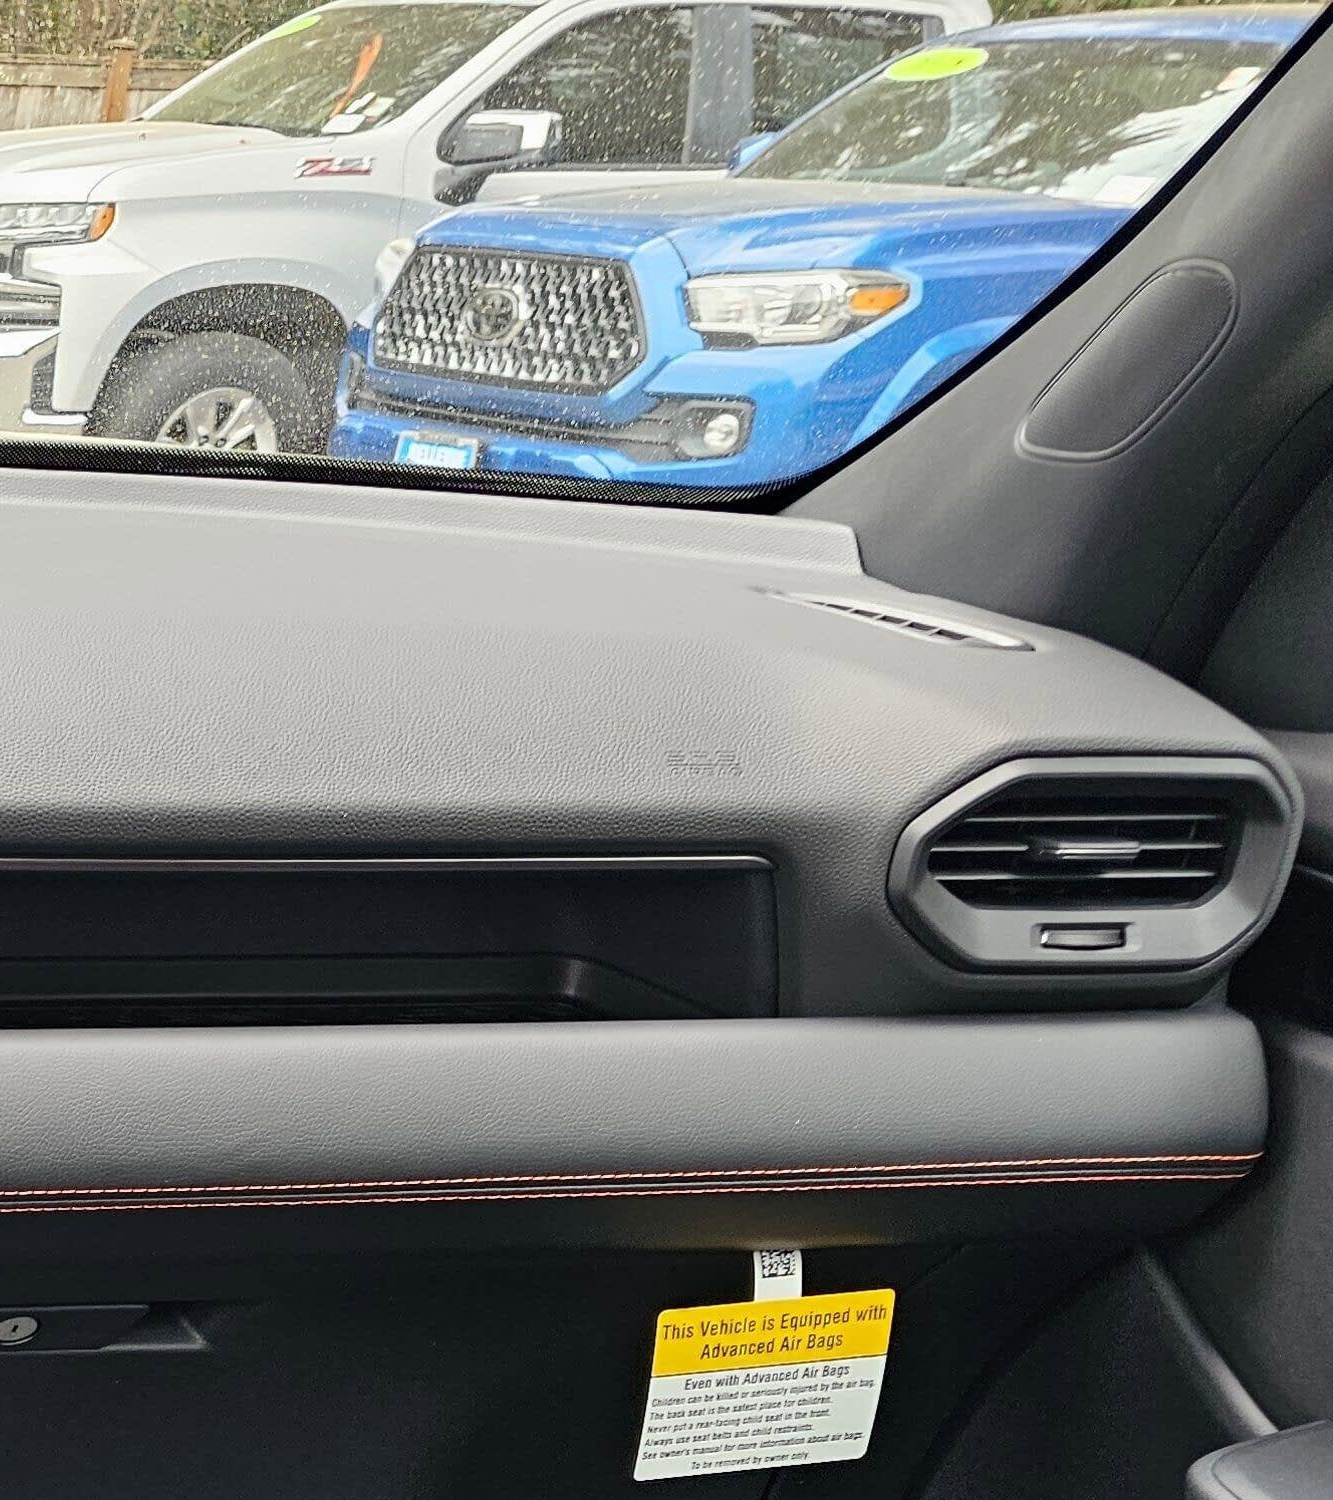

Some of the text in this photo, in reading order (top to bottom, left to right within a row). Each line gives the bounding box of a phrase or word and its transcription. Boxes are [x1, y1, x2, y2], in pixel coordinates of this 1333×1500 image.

[663, 1304, 887, 1341] This Vehicle is Equipped with
[700, 1333, 844, 1360] Advanced Air Bags
[684, 1365, 850, 1391] Even with Advanced Air Bags
[652, 1397, 684, 1407] Children
[688, 1396, 703, 1404] can
[704, 1394, 714, 1402] be
[717, 1391, 740, 1401] killed
[821, 1383, 830, 1392] by
[650, 1412, 664, 1421] The
[667, 1410, 685, 1419] back
[688, 1408, 706, 1417] seat
[708, 1407, 715, 1415] is
[717, 1405, 731, 1414] the
[759, 1401, 782, 1411] place
[784, 1399, 796, 1408] for
[647, 1424, 670, 1434] Never
[673, 1423, 687, 1432] put
[696, 1417, 741, 1429] rear-facing
[743, 1415, 763, 1425] child
[645, 1438, 673, 1448] Always
[675, 1436, 690, 1444] use
[693, 1434, 711, 1443] seat
[734, 1428, 750, 1438] and
[642, 1451, 657, 1460] See
[660, 1447, 690, 1458] owner's
[691, 1453, 789, 1470] To be removed by owner
